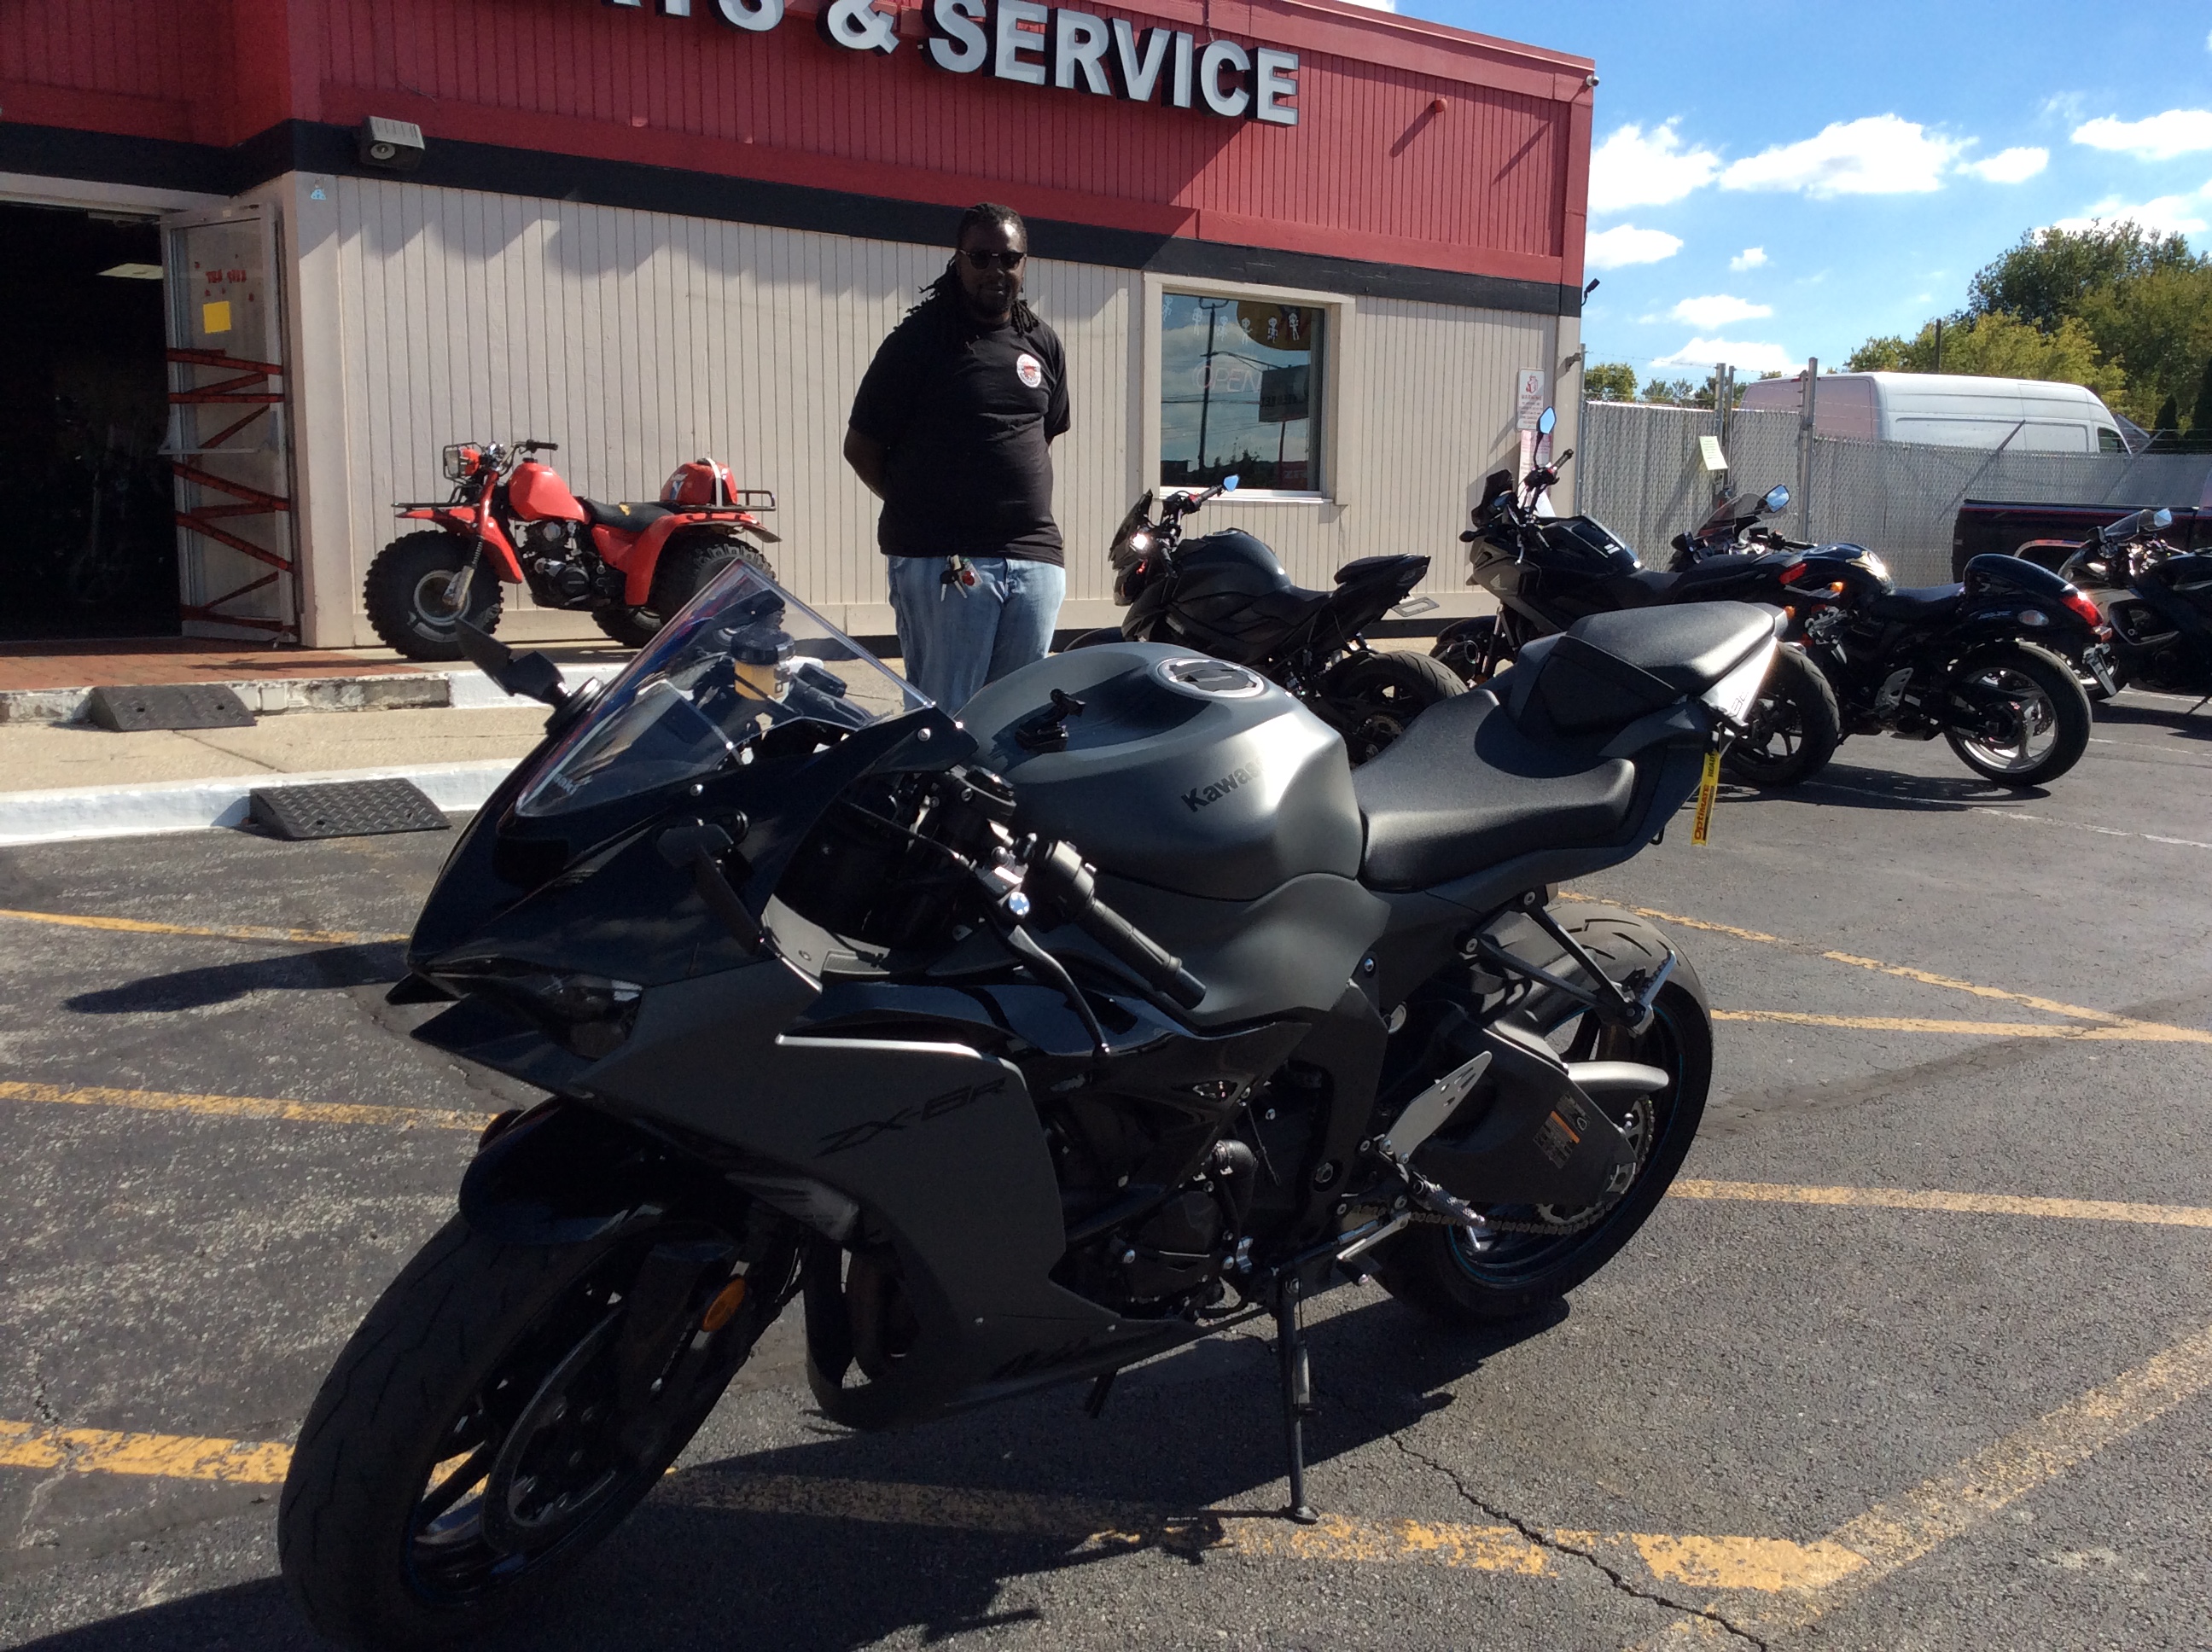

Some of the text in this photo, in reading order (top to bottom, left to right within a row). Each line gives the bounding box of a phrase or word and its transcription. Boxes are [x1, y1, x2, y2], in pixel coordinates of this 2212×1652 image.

[827, 0, 1298, 125] & SERVICE
[1196, 365, 1261, 393] OPEN
[1180, 760, 1263, 813] Kawas
